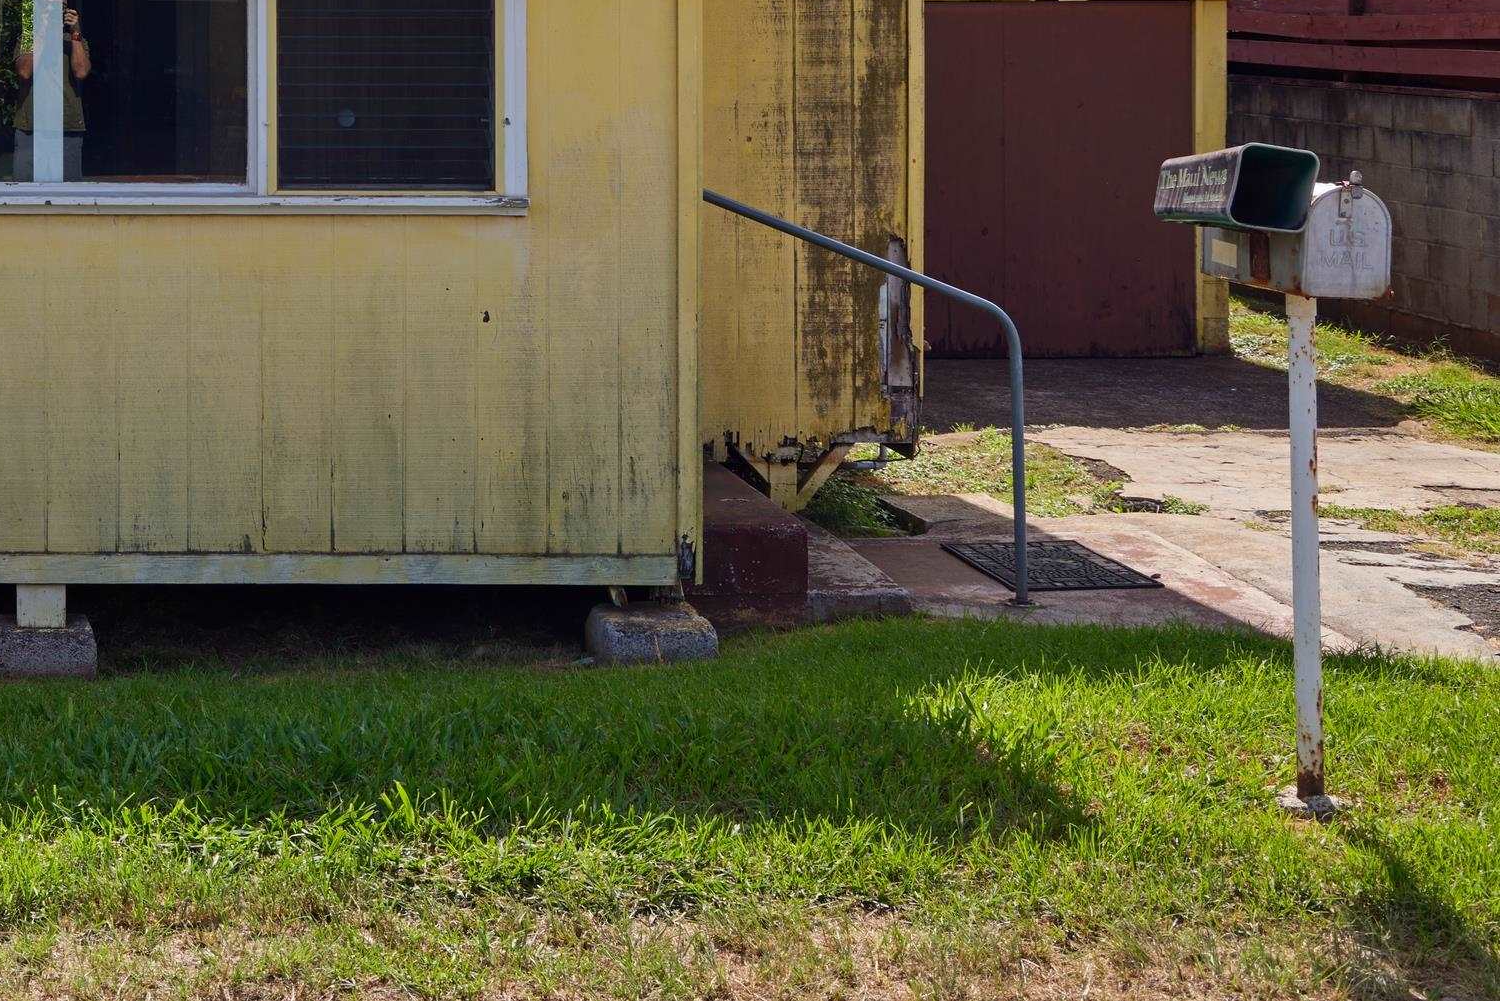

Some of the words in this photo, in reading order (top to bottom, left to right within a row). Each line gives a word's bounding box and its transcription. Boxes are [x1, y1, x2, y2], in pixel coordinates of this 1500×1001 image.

[1160, 169, 1178, 189] The
[1178, 166, 1202, 188] Maui
[1202, 165, 1228, 186] News
[1316, 250, 1373, 270] MAIL
